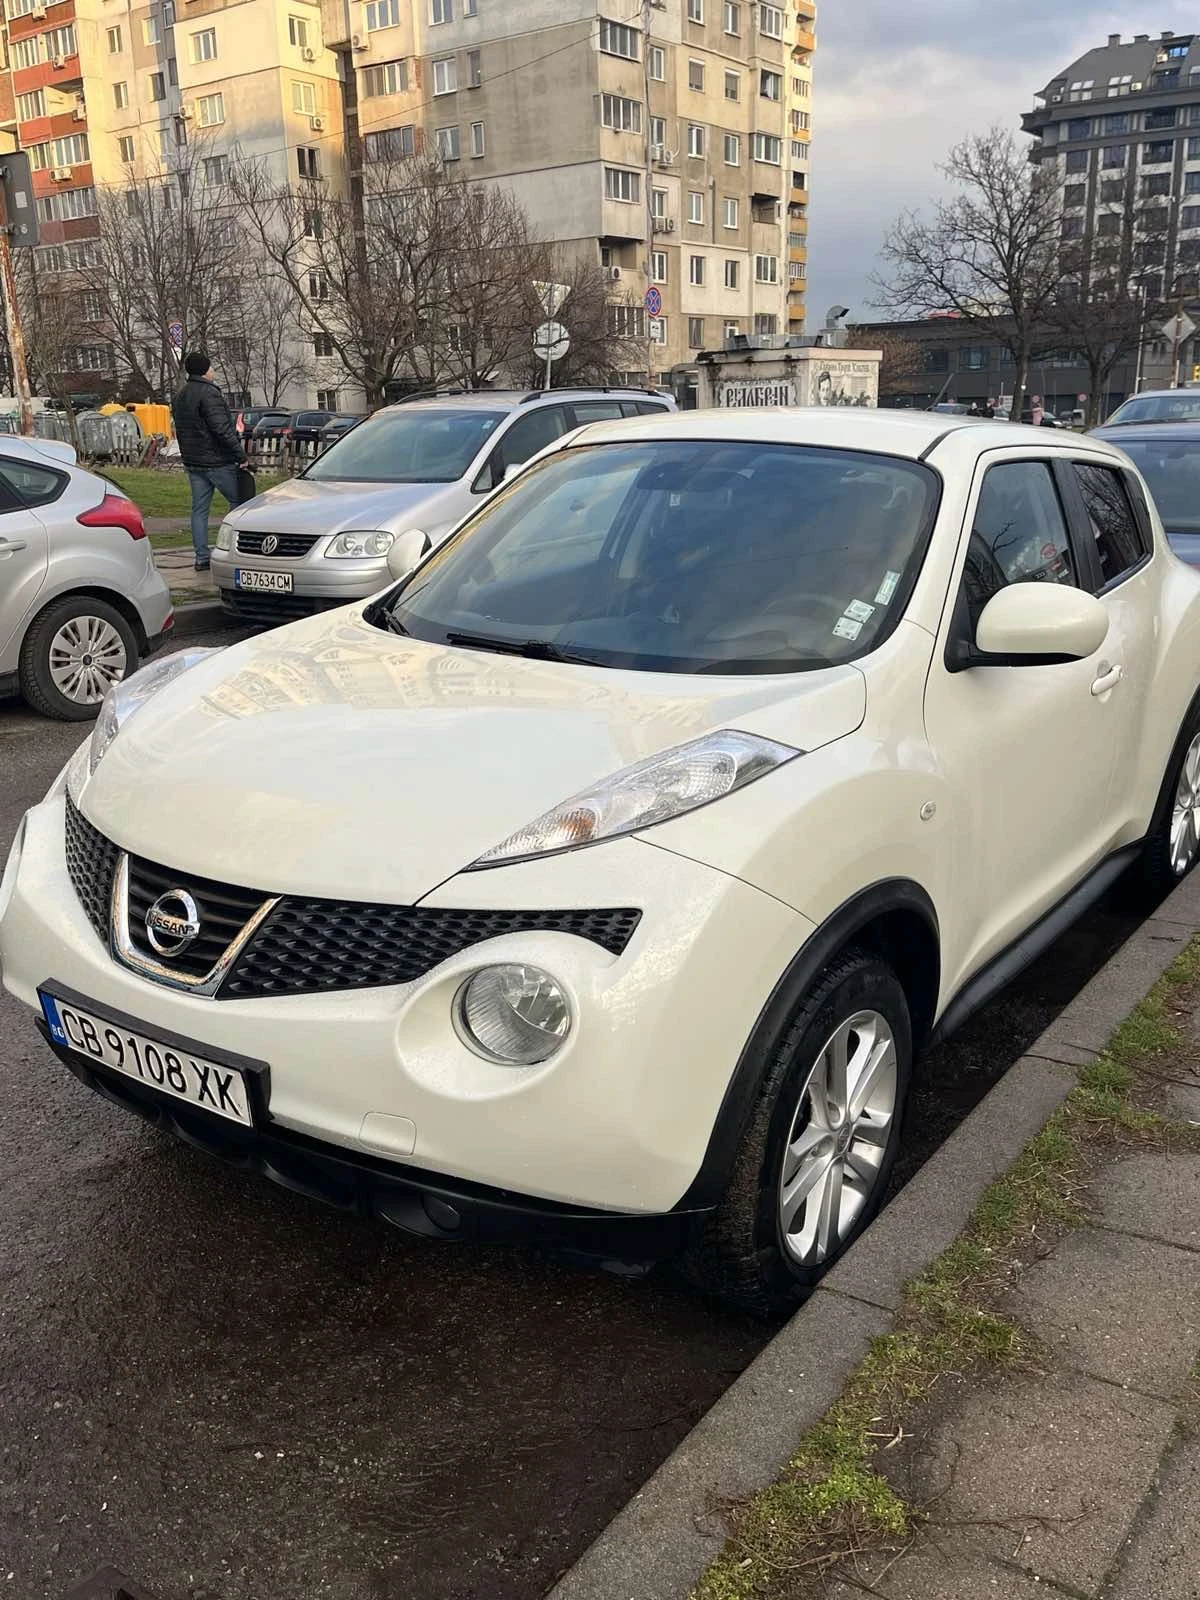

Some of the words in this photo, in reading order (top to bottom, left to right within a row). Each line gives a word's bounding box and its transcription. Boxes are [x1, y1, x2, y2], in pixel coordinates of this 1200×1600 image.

[241, 572, 252, 585] CB
[253, 573, 276, 588] 7634
[277, 575, 290, 589] CM
[61, 1009, 104, 1057] CB
[105, 1029, 187, 1093] 9108
[190, 1061, 242, 1117] XK
